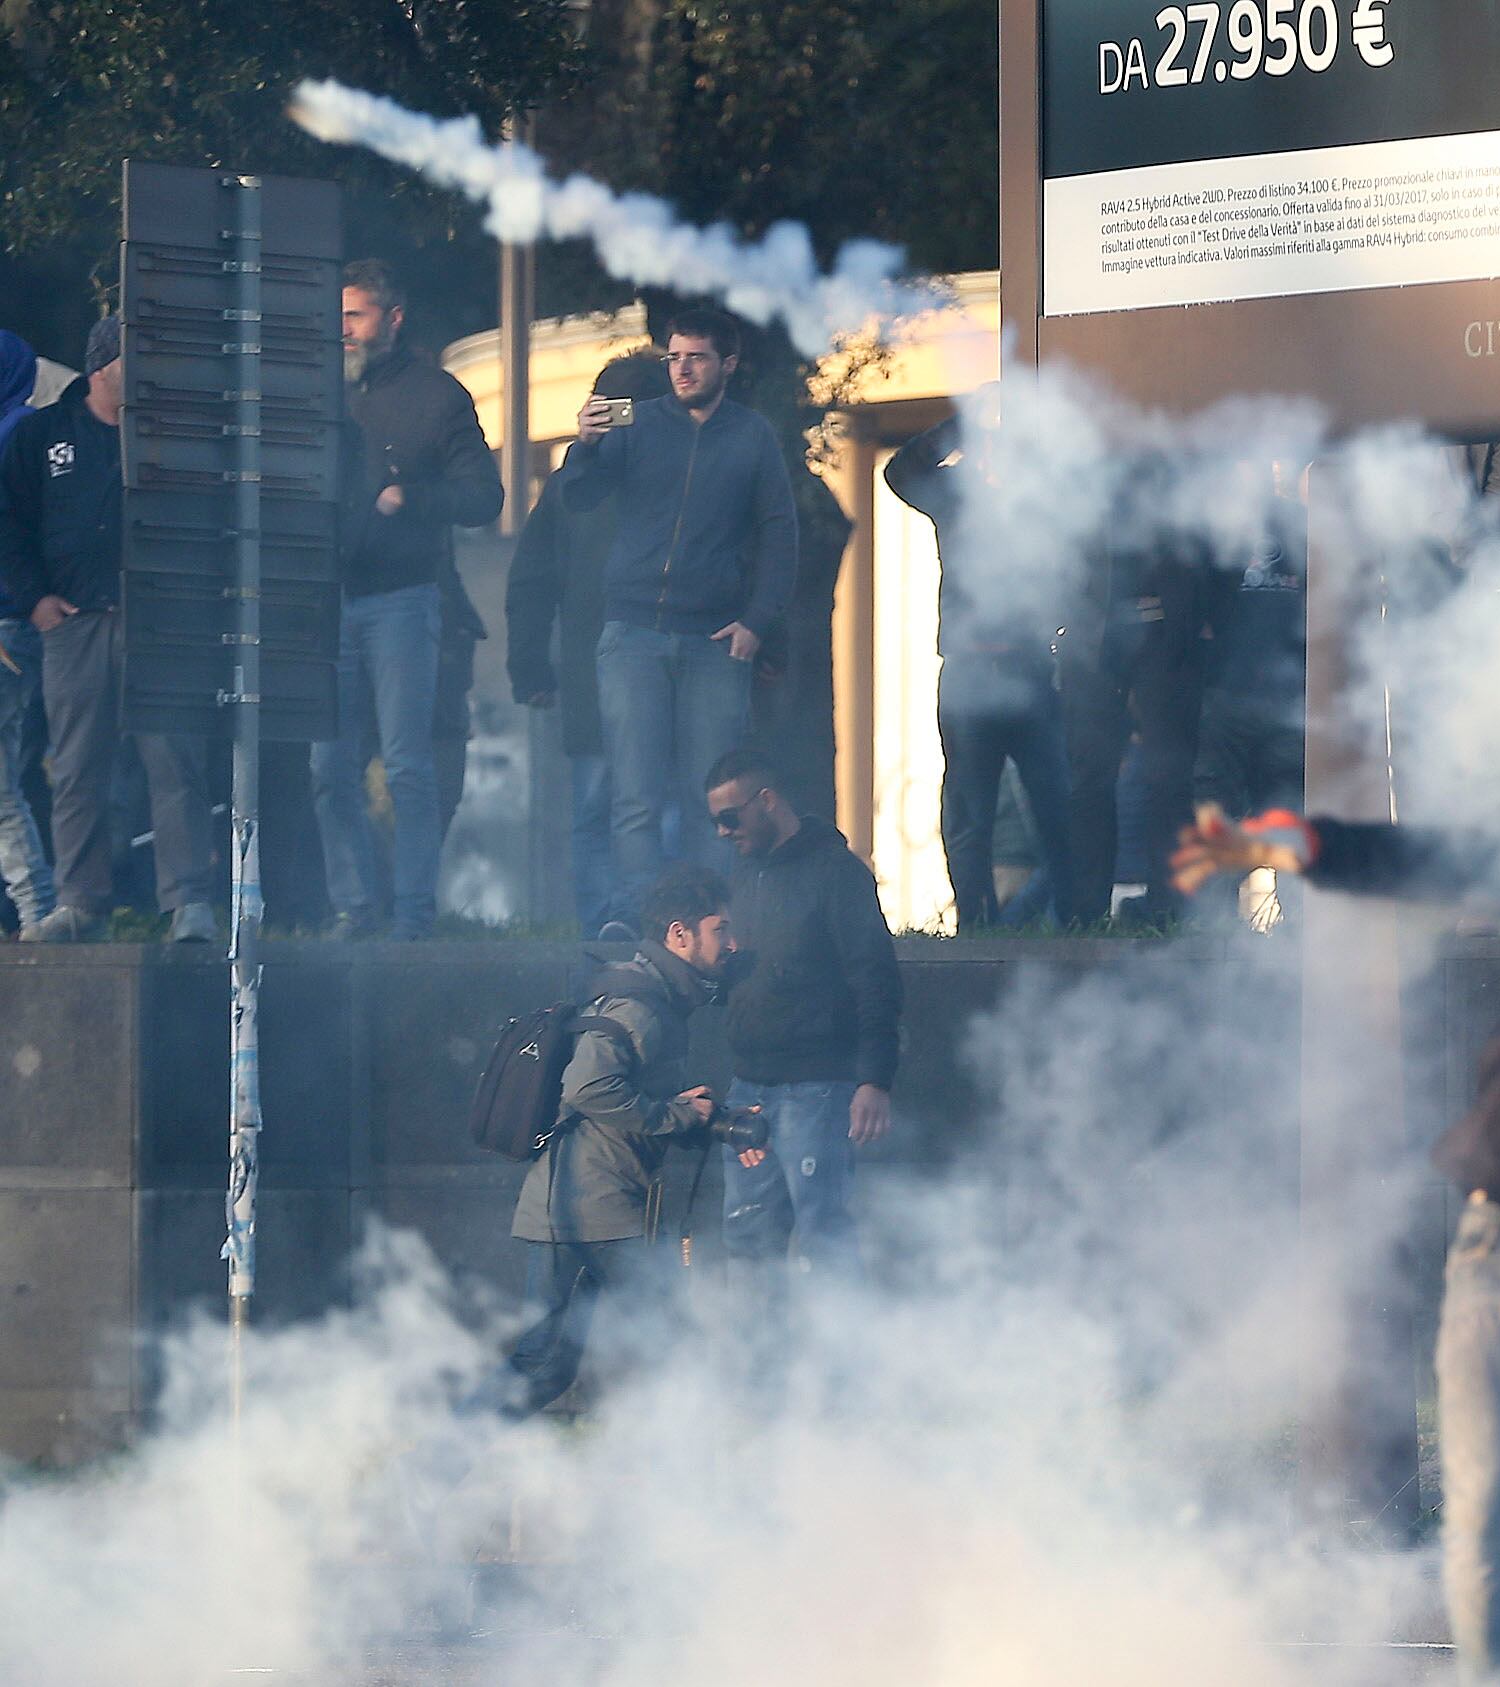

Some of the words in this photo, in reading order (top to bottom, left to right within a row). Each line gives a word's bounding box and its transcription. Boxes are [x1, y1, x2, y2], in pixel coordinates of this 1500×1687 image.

[1099, 39, 1149, 94] DA
[1154, 0, 1339, 87] 27.950
[1351, 0, 1395, 68] €
[1101, 200, 1126, 215] RAV4
[1127, 198, 1141, 213] 2.5
[1142, 195, 1171, 214] Hybrid
[1172, 194, 1201, 208] Active
[1202, 190, 1226, 205] 2WD.
[1228, 189, 1257, 202] Prezzo
[1269, 184, 1295, 198] listino
[1297, 179, 1329, 195] 34.100
[1342, 177, 1372, 190] Prezzo
[1374, 169, 1434, 190] promozionale
[1436, 167, 1463, 181] chiavi
[1475, 167, 1500, 178] mano
[1101, 218, 1146, 235] contributo
[1147, 215, 1168, 230] della
[1170, 216, 1190, 227] casa
[1199, 209, 1212, 224] del
[1214, 205, 1281, 222] concessionario.
[1282, 202, 1315, 216] Offerta
[1316, 198, 1343, 213] valida
[1344, 197, 1362, 210] fino
[1373, 189, 1429, 208] 31/03/2017,
[1431, 187, 1449, 201] solo
[1462, 187, 1482, 198] caso
[1101, 239, 1135, 255] risultati
[1136, 235, 1171, 251] ottenuti
[1172, 236, 1189, 247] con
[1222, 228, 1246, 242] Drive
[1248, 224, 1269, 239] della
[1314, 219, 1335, 232] base
[1346, 215, 1364, 229] dati
[1366, 213, 1380, 227] del
[1382, 212, 1416, 225] sistema
[1418, 205, 1470, 224] diagnostico
[1472, 202, 1486, 216] del
[1101, 257, 1143, 274] Immagine
[1145, 254, 1176, 268] vettura
[1178, 249, 1223, 265] indicativa.
[1224, 246, 1250, 260] Valori
[1251, 242, 1286, 258] massimi
[1287, 240, 1315, 254] riferiti
[1316, 238, 1332, 252] alla
[1333, 238, 1365, 253] gamma
[1366, 232, 1392, 247] RAV4
[1394, 229, 1426, 248] Hybrid:
[1428, 229, 1469, 242] consumo
